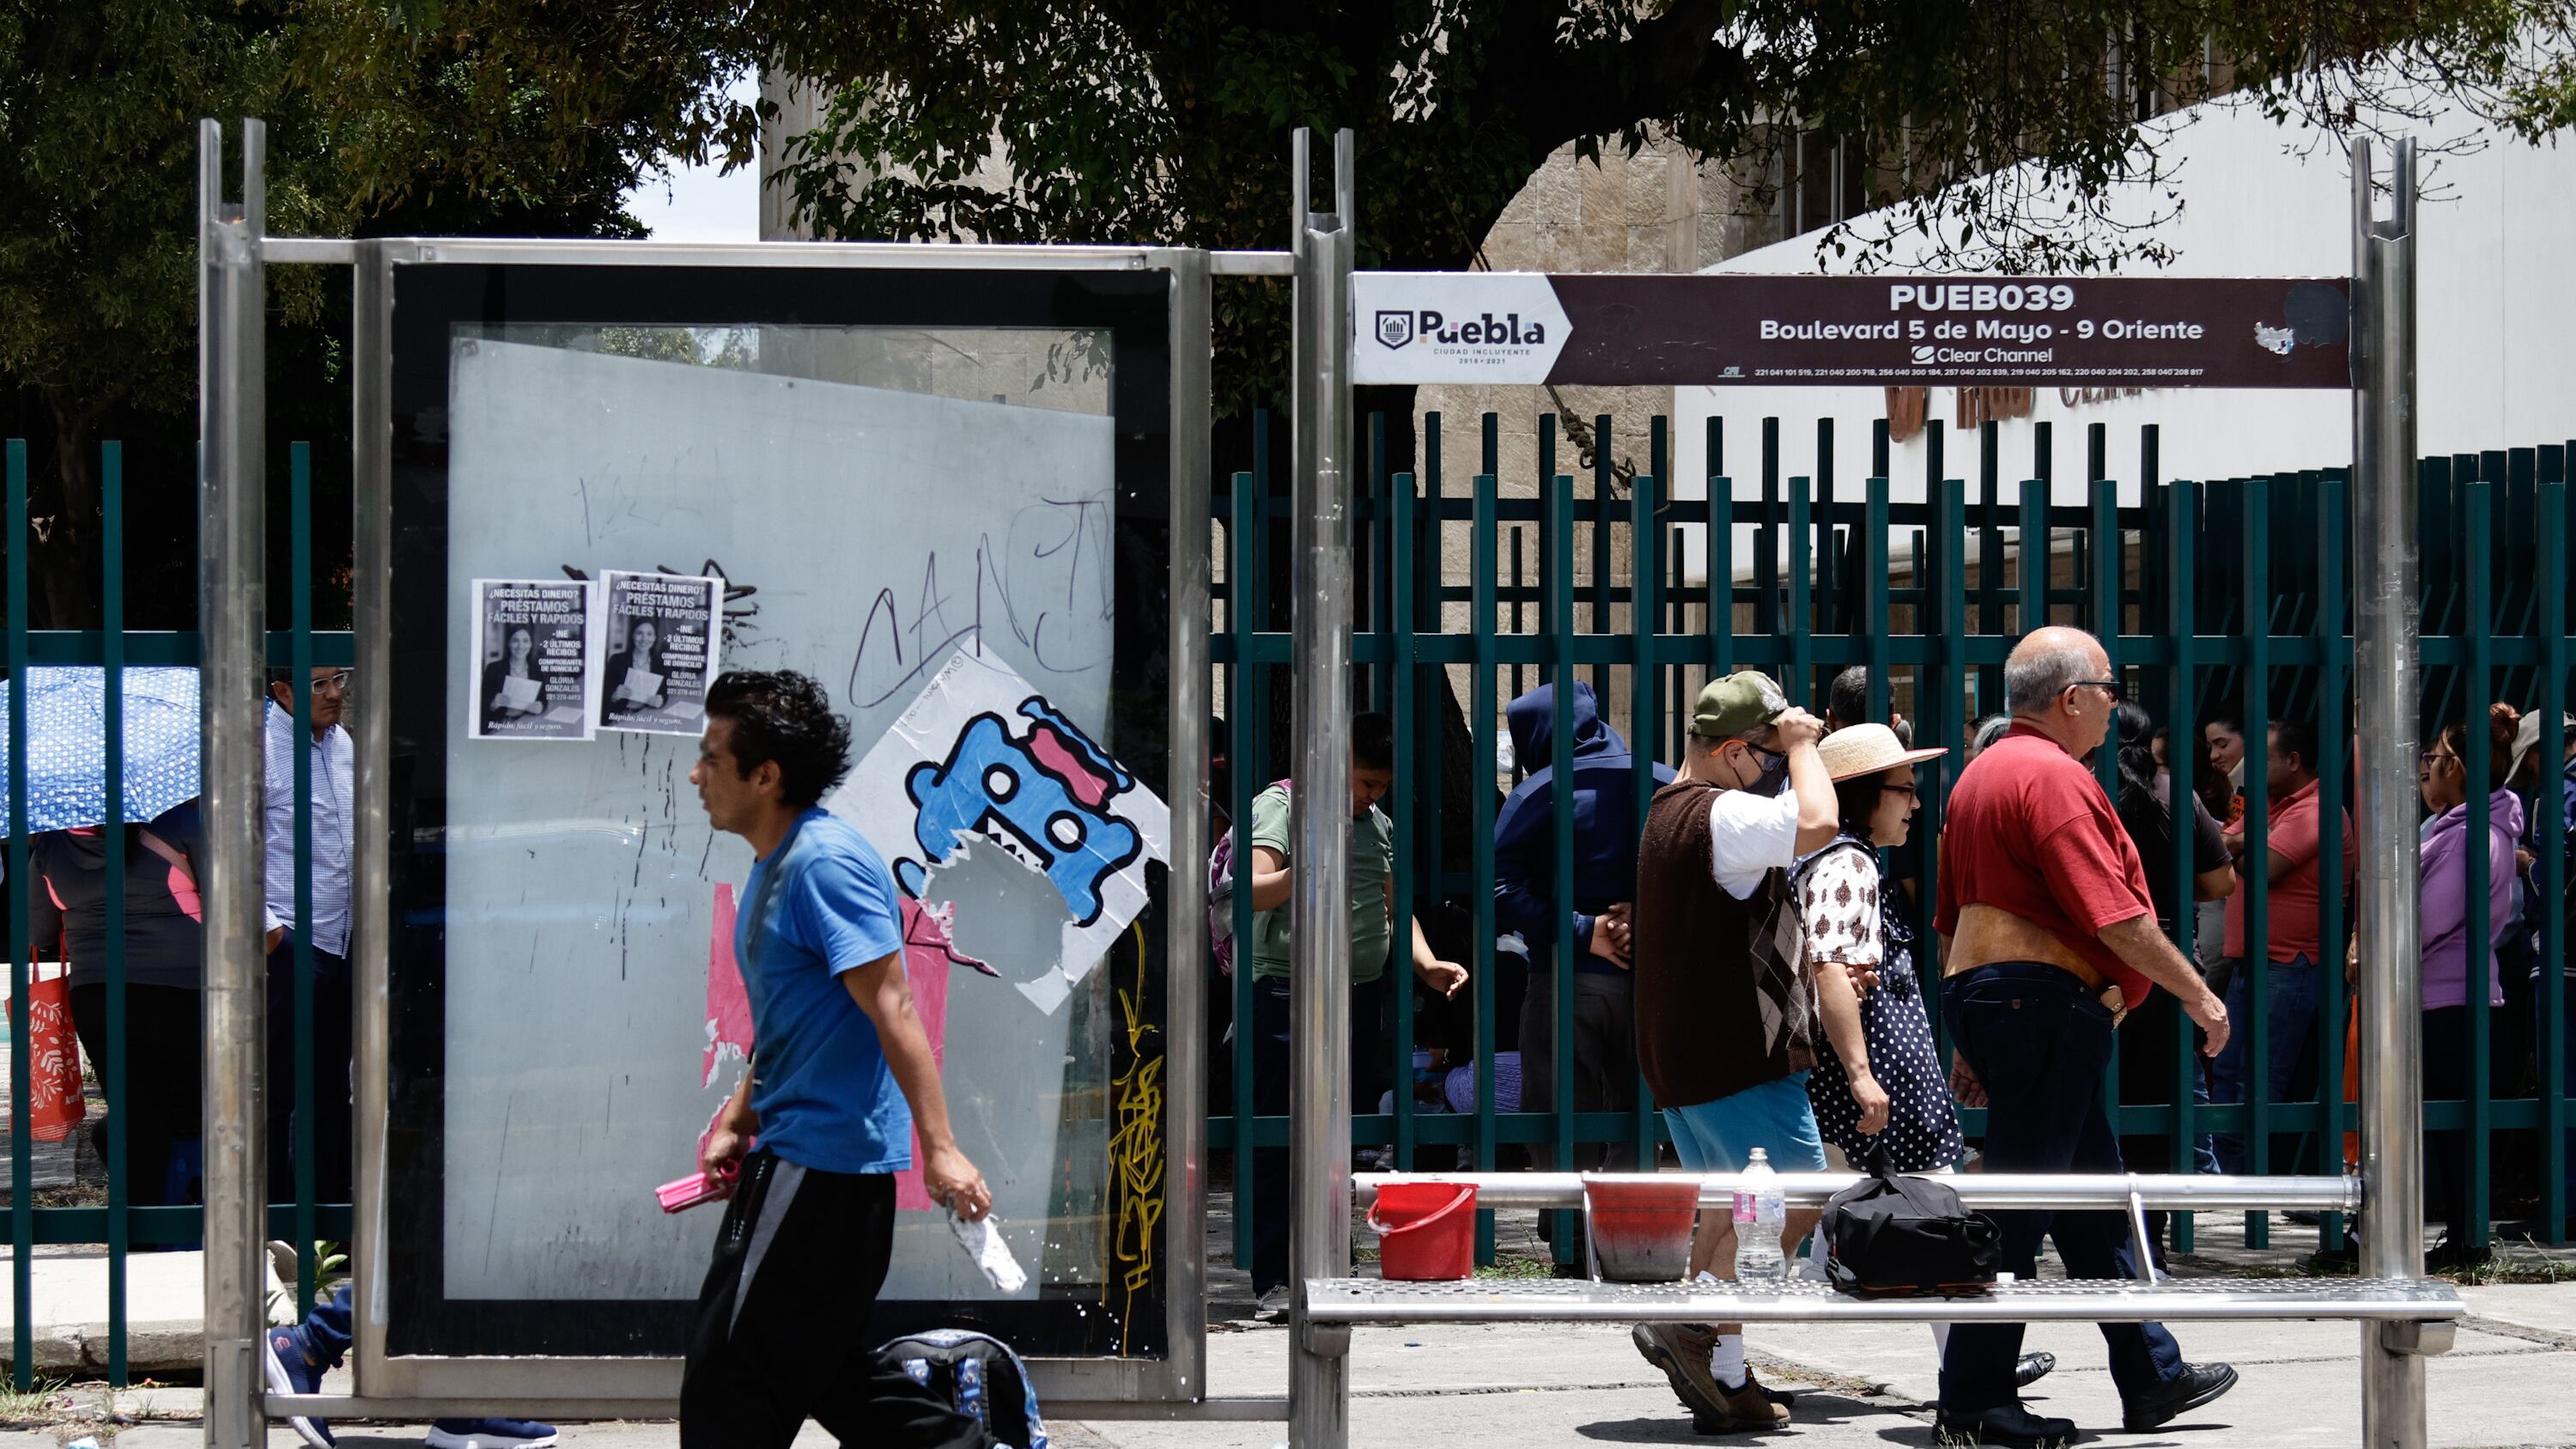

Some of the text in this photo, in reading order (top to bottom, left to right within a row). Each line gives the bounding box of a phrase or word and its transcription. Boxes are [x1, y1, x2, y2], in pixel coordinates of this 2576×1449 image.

[1890, 284, 2075, 311] PUEB039
[1419, 310, 1545, 344] Puebla
[1760, 320, 1899, 340] Boulevard
[1908, 320, 1926, 340] 5
[1934, 320, 1967, 340] de
[1975, 320, 2053, 344] Mayo
[2076, 320, 2094, 340] 9
[2102, 320, 2205, 340] Oriente
[1937, 347, 2053, 362] Clear Channel
[1798, 368, 1814, 377] 519,
[1928, 368, 1943, 377] 184,
[1993, 368, 2010, 377] 839,
[2058, 368, 2073, 377] 162,
[2123, 368, 2141, 377] 202,
[489, 588, 578, 599] ¿NECESITAS DINERO?
[616, 581, 705, 594] ¿NECESITAS DINERO?
[501, 599, 569, 612] PRÉSTAMOS
[626, 592, 695, 608] PRÉSTAMOS
[487, 610, 583, 624] FÁCILES Y RAPIDOS
[613, 601, 708, 620] FÁCILES Y RAPIDOS
[550, 639, 581, 648] ÚLTIMOS
[673, 634, 705, 645] ÚLTIMOS
[670, 642, 701, 652] RECIBOS
[661, 653, 705, 662] COMPROBANTE
[672, 660, 702, 668] DOMICILIO
[671, 671, 696, 679] GLORIA
